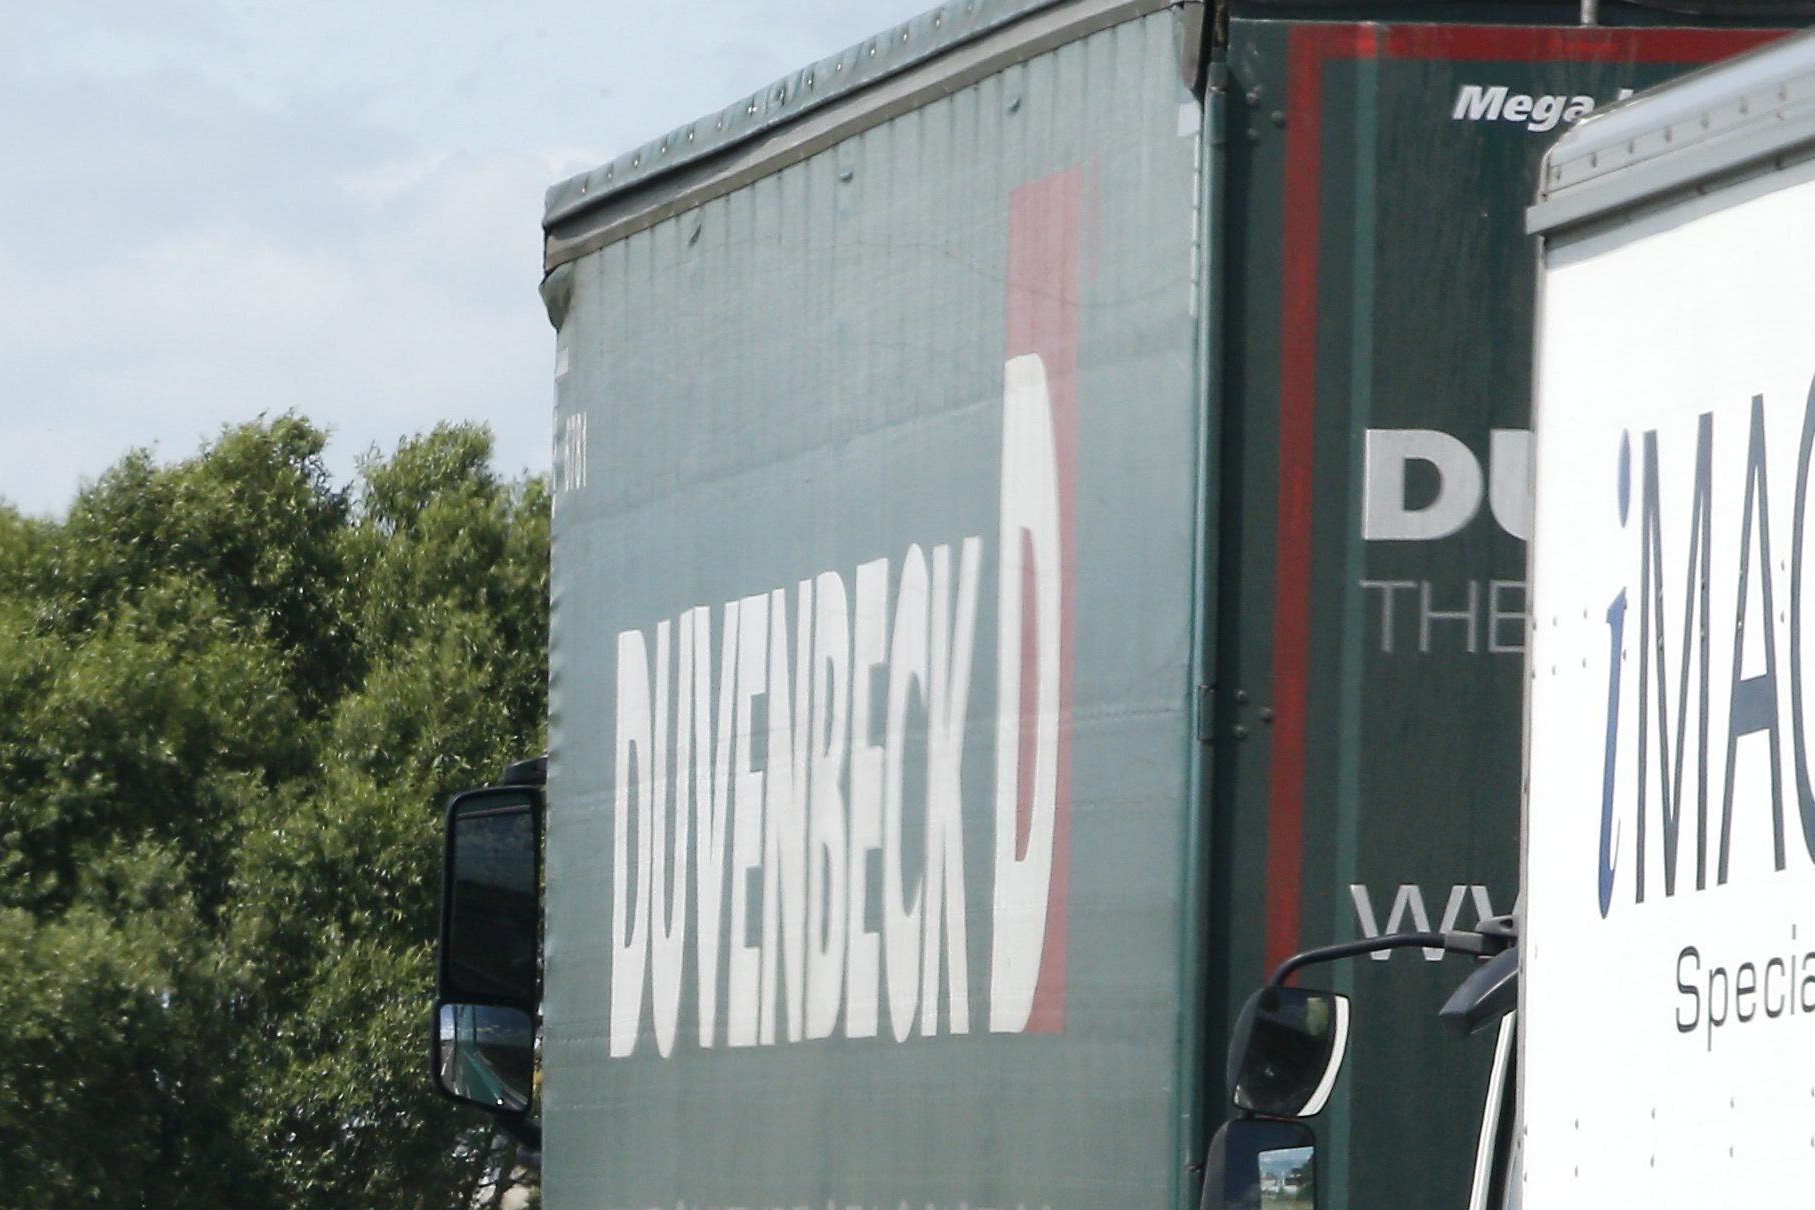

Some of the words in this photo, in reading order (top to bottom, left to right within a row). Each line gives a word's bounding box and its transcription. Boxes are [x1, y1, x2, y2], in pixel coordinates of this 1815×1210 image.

[1452, 84, 1595, 132] Mega
[1359, 580, 1526, 652] THE
[610, 535, 982, 1059] DUVENBECK
[990, 353, 1062, 1033] D
